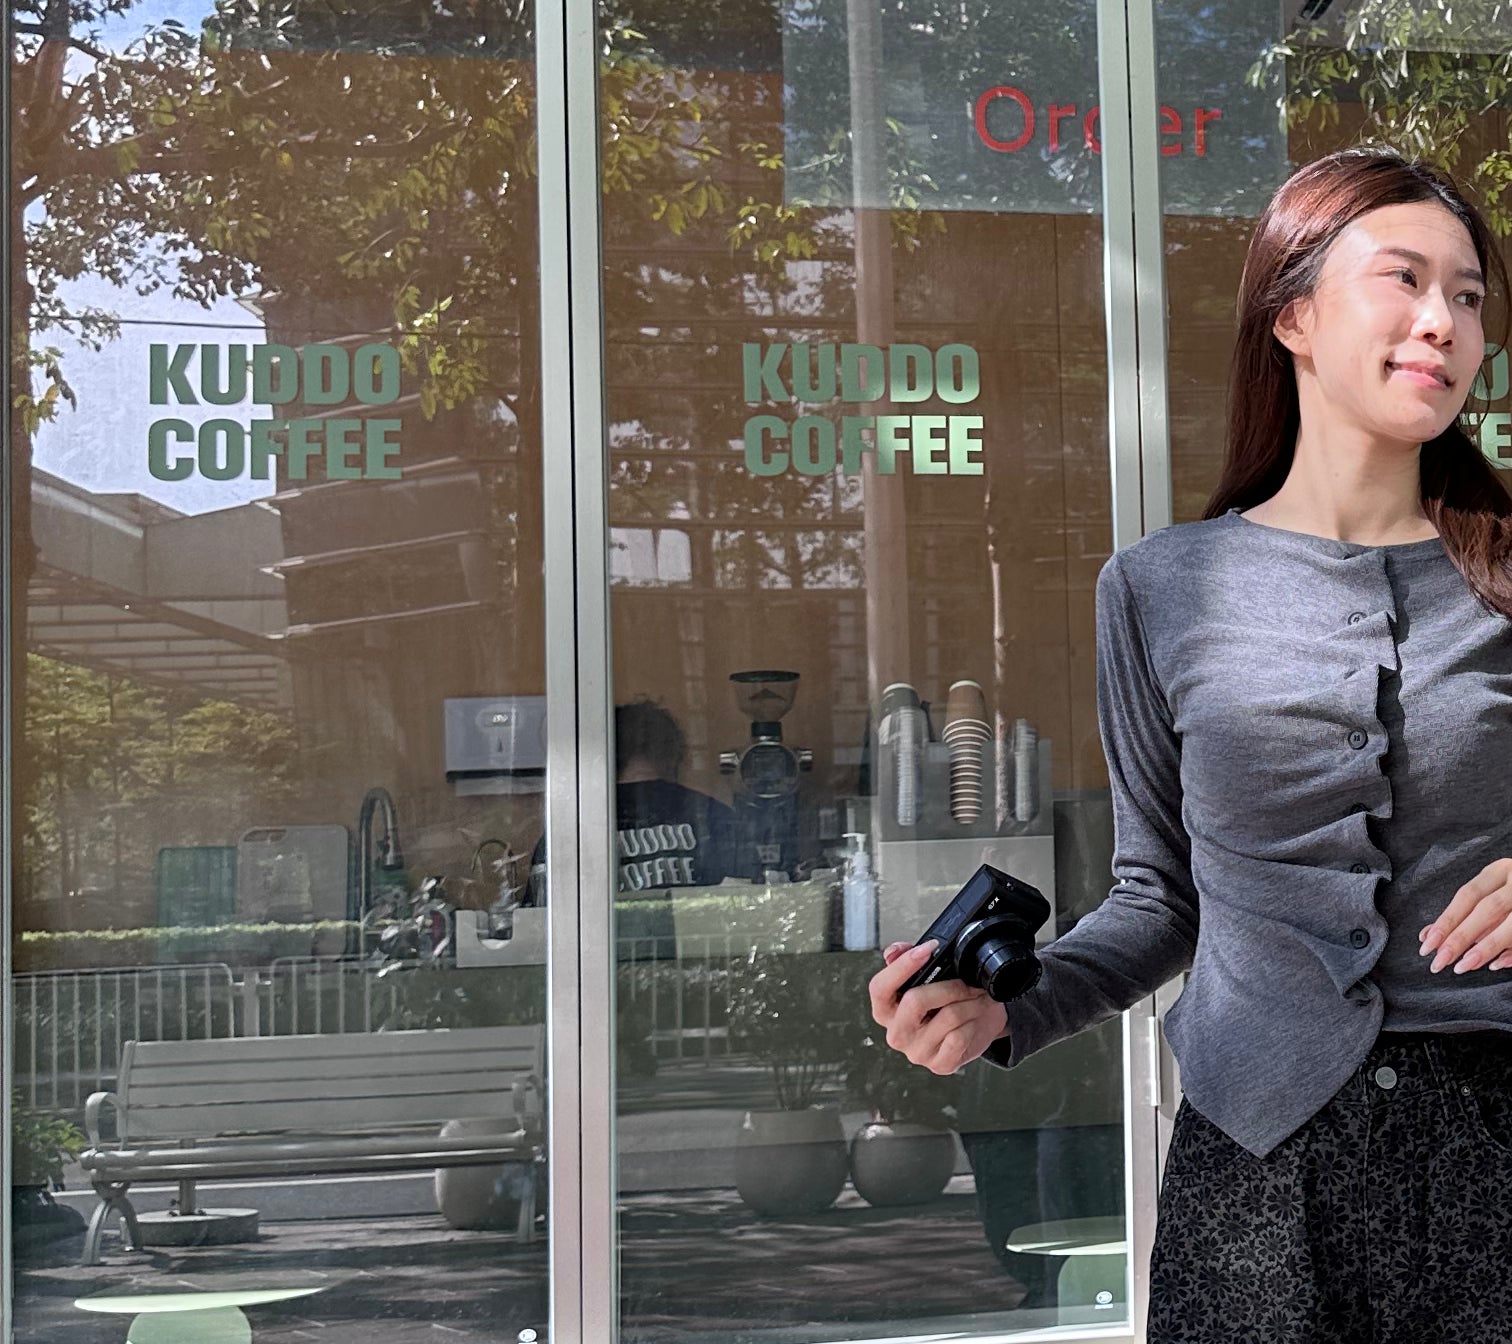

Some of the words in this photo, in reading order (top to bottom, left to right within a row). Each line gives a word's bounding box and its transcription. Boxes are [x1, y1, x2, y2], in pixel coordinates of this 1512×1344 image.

[148, 343, 401, 405] KUDDO
[742, 342, 980, 404] KUDDO
[148, 418, 402, 480] COFFEE
[743, 415, 984, 476] COFFEE
[618, 823, 697, 857] UDDO
[619, 857, 696, 892] OFFEE
